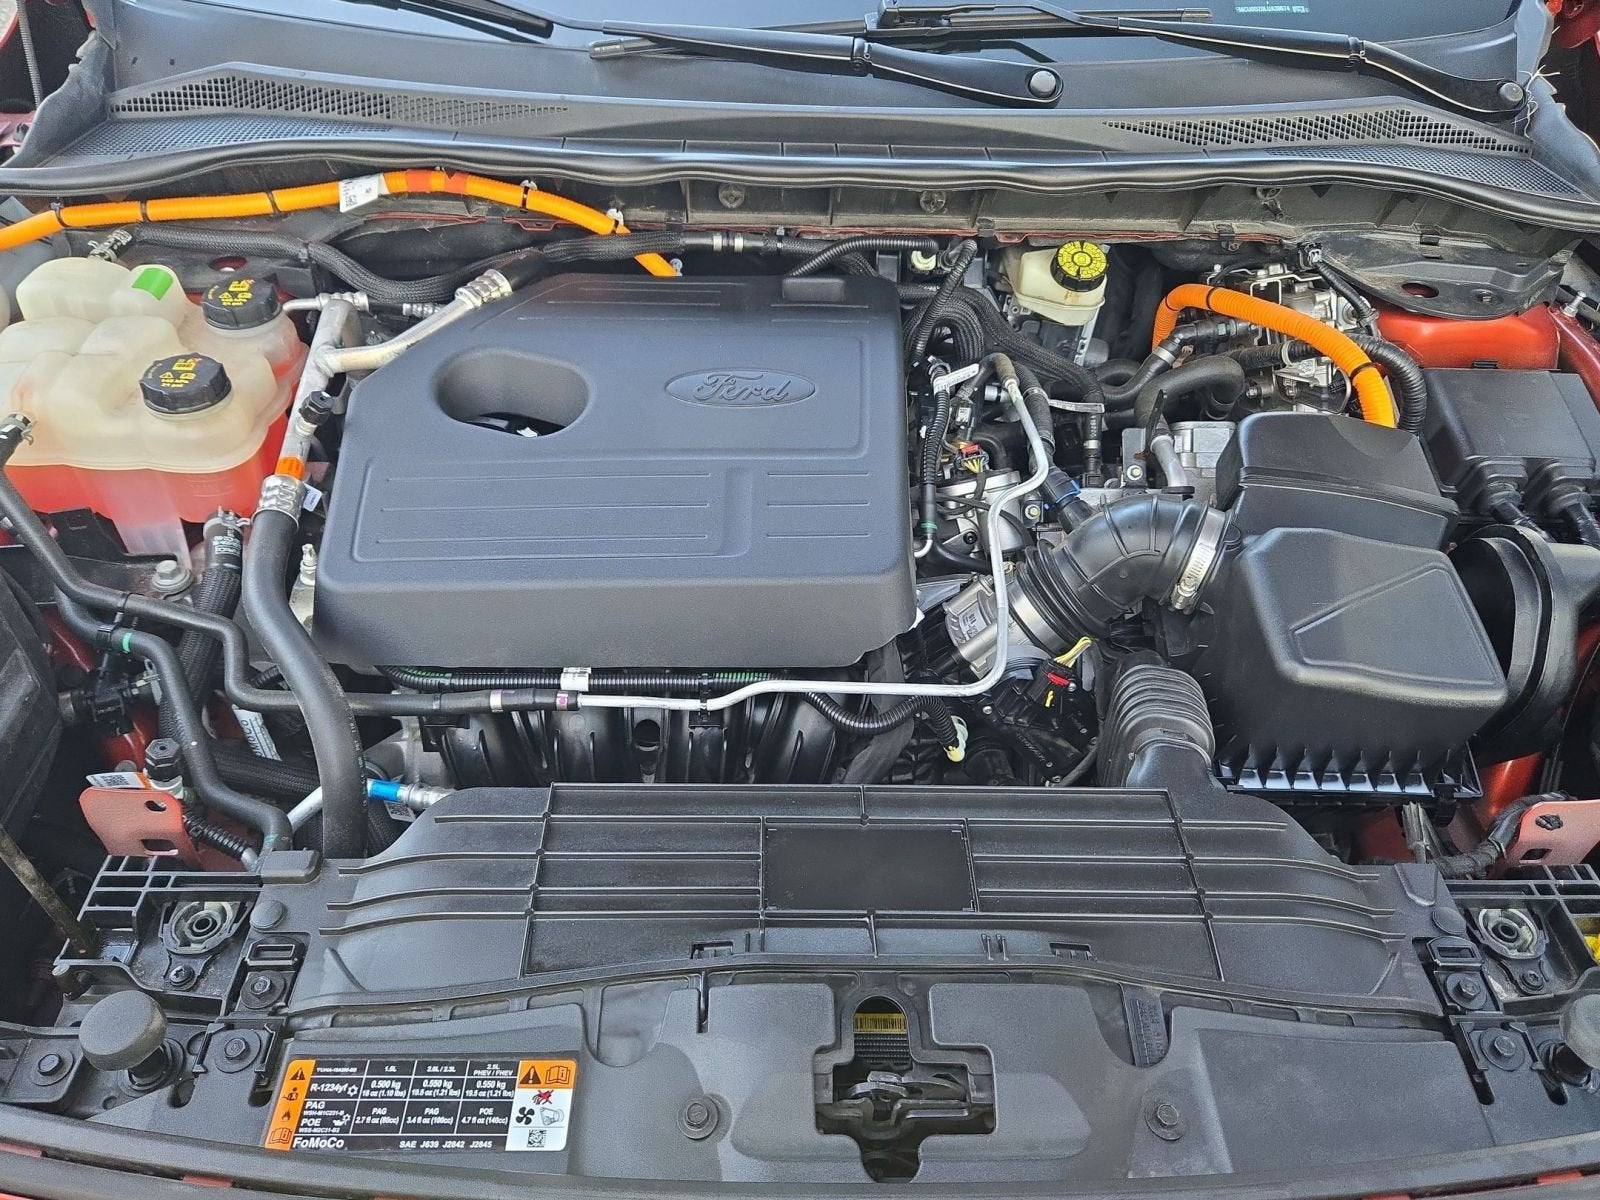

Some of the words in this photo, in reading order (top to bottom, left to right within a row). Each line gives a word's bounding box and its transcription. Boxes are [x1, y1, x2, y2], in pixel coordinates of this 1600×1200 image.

[693, 373, 792, 402] Ford
[310, 1082, 349, 1093] R-1234yf
[370, 1079, 391, 1089] 0.500
[391, 1079, 401, 1090] kg
[422, 1079, 443, 1088] 0.550
[443, 1079, 453, 1089] kg
[476, 1080, 496, 1089] 0.550
[496, 1080, 507, 1090] kg
[305, 1101, 325, 1109] PAG
[371, 1107, 387, 1115] PAG
[424, 1107, 440, 1115] PAG
[479, 1107, 494, 1115] POE
[300, 1118, 321, 1127] POE
[461, 1116, 472, 1124] 4.7
[292, 1137, 344, 1148] FoMoCo
[399, 1140, 417, 1148] SAE
[420, 1140, 439, 1148] J639
[442, 1140, 465, 1148] J2842
[469, 1140, 492, 1148] J2845
